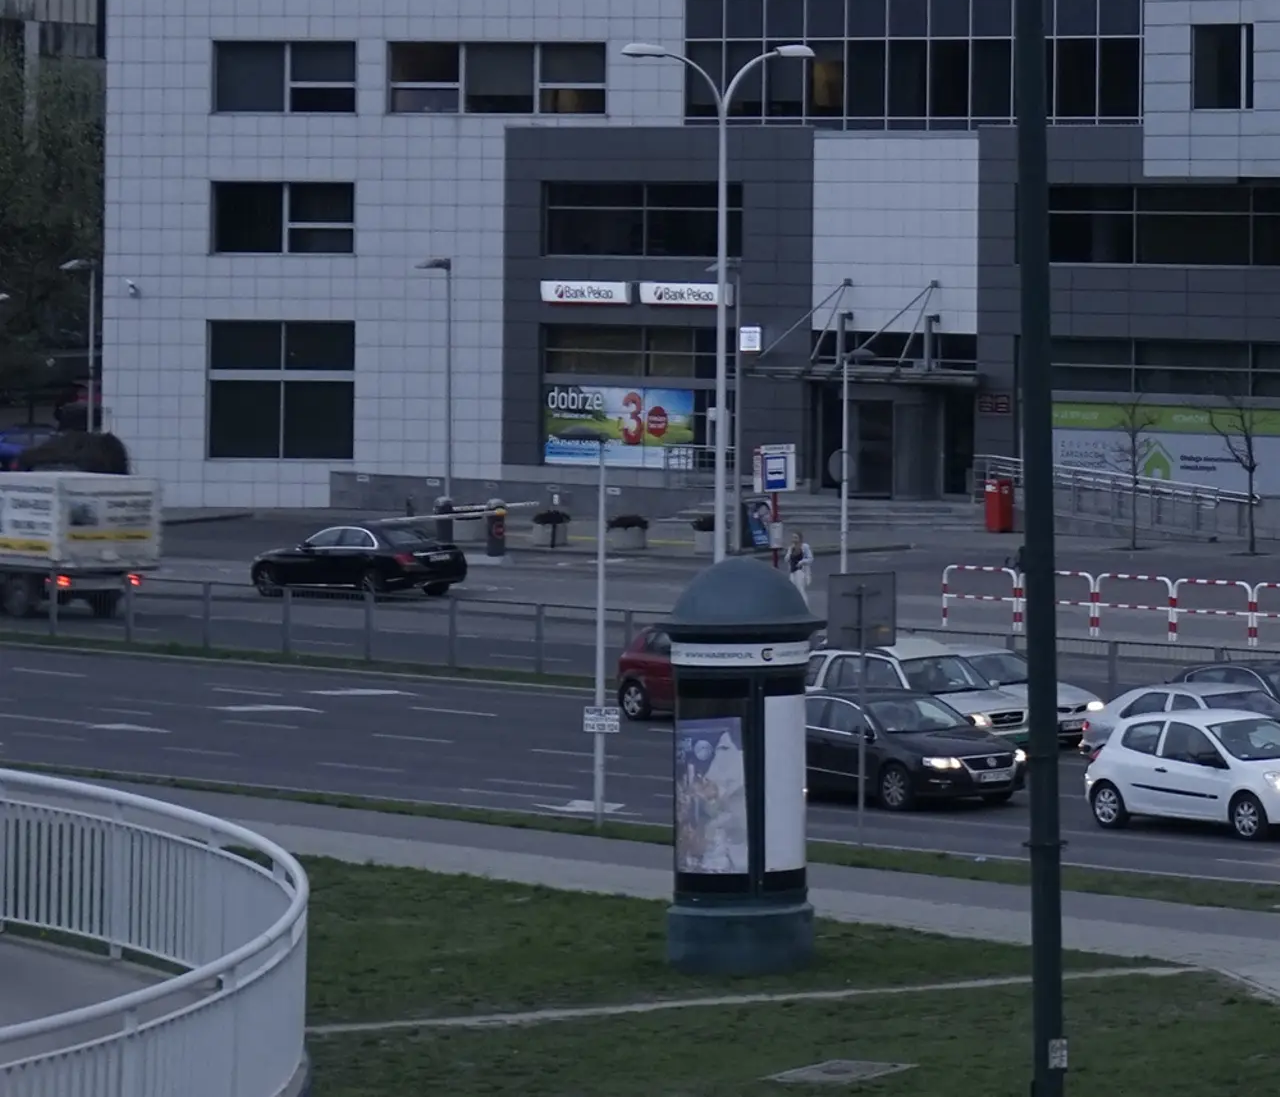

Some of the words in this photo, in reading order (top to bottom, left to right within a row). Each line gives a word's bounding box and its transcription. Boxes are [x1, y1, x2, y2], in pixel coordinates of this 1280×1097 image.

[564, 285, 586, 299] Bank
[587, 285, 613, 299] Pekao
[663, 287, 685, 301] Bank
[686, 287, 714, 301] Pekao
[547, 386, 603, 410] dobrze
[622, 391, 644, 446] 3
